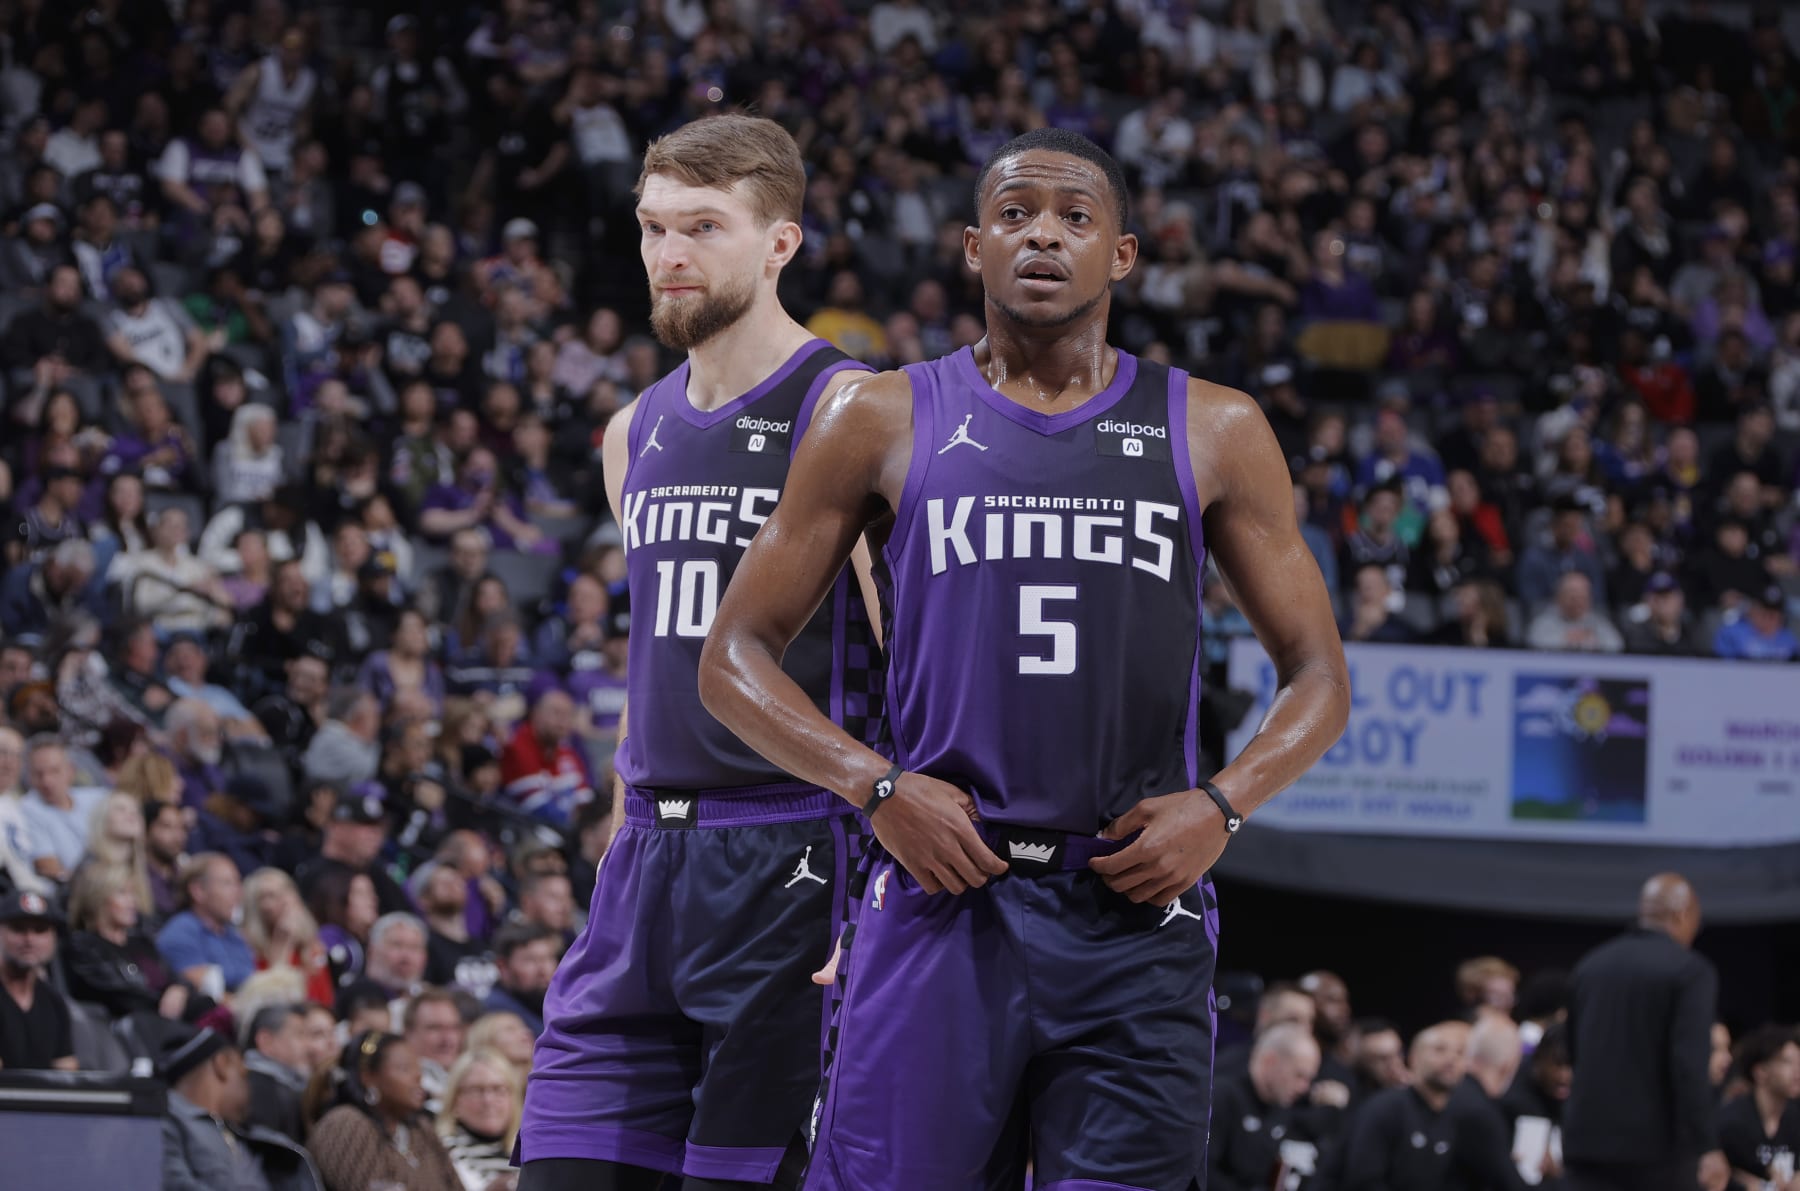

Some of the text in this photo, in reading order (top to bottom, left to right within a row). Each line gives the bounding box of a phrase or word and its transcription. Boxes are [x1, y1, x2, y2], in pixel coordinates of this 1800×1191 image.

[736, 415, 791, 434] dialpad
[1097, 420, 1166, 439] dialpad
[650, 485, 738, 499] SACRAMENTO
[984, 495, 1125, 511] SACRAMENTO
[926, 496, 1180, 583] KINGS
[654, 560, 718, 638] 10
[1018, 585, 1077, 675] 5
[1387, 664, 1489, 719] OUT
